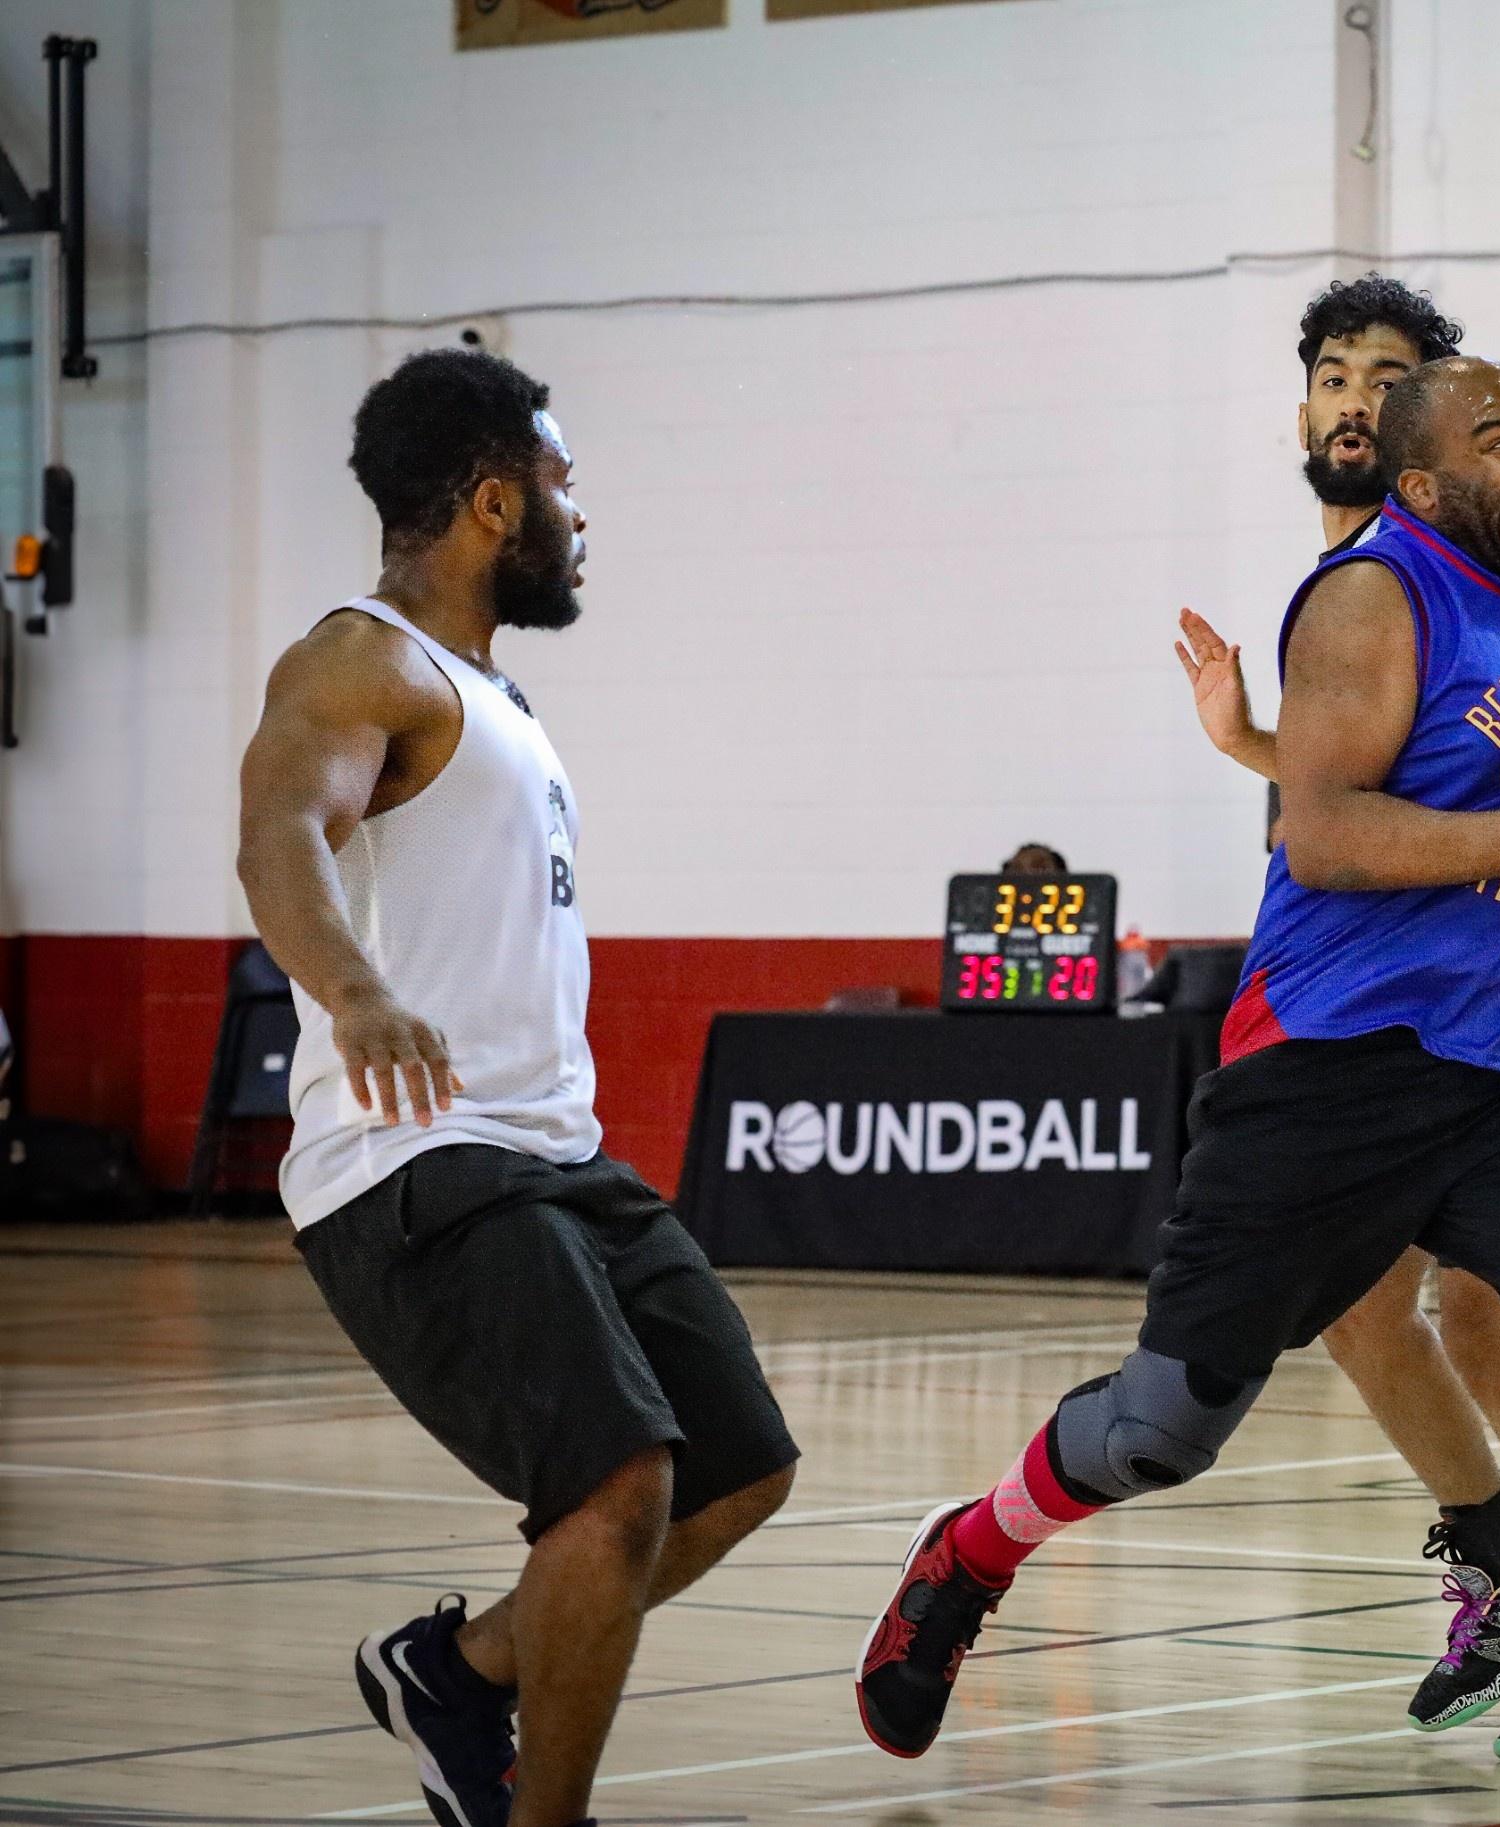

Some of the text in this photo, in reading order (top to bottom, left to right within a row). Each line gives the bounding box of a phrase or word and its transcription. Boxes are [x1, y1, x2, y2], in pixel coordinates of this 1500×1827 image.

[992, 884, 1085, 934] 3:22
[958, 955, 1003, 1000] 35
[1048, 955, 1100, 1000] 20
[725, 1097, 1152, 1175] ROUNDBALL
